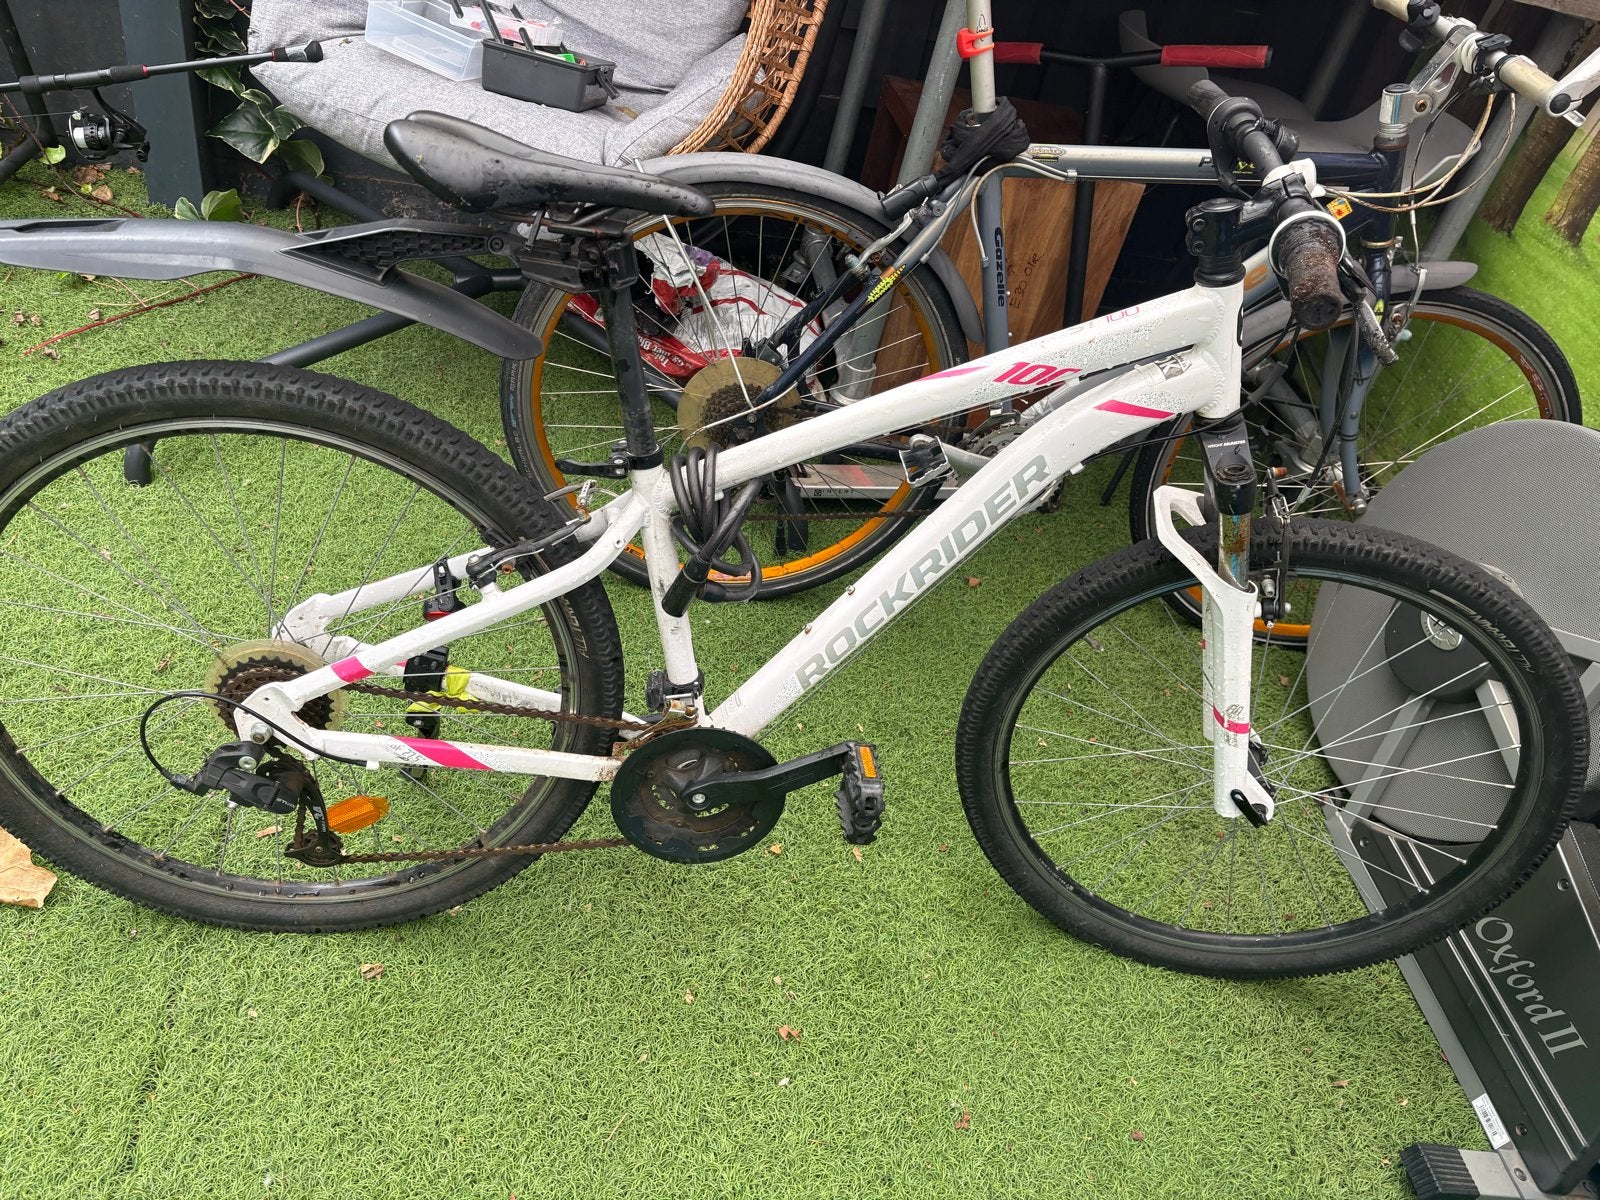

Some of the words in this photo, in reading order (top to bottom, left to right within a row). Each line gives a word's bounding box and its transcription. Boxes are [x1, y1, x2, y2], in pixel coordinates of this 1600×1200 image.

[994, 226, 1005, 308] Gazelle
[794, 454, 1052, 691] ROCKRIDER
[1475, 916, 1567, 1025] Oxford
[1537, 1020, 1588, 1060] II
